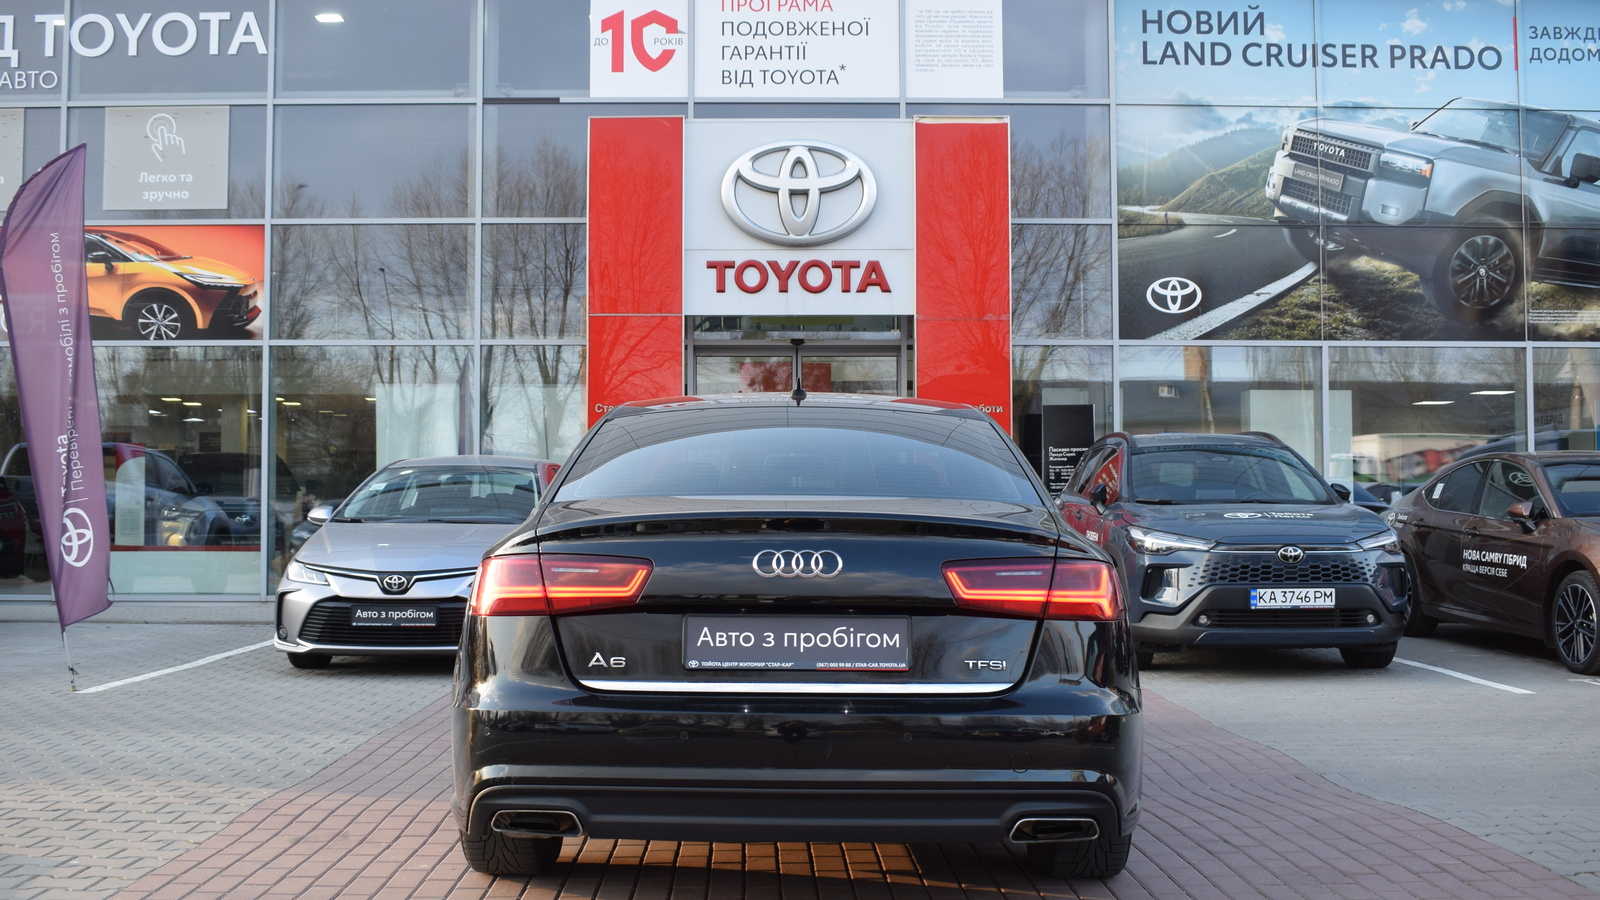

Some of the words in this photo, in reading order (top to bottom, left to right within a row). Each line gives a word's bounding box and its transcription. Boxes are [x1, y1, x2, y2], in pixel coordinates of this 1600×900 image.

[721, 17, 871, 38] ПОДОВЖЕНОЇ
[1141, 4, 1265, 36] НОВИЙ
[35, 11, 268, 58] TOYOTA
[593, 37, 609, 47] ДО
[653, 37, 684, 46] РОКІВ
[1528, 25, 1600, 43] ЗАВЖД
[721, 41, 807, 60] ГАРАНТІЇ
[1141, 40, 1233, 66] LAND
[1241, 42, 1379, 69] CRUISER
[1389, 44, 1503, 71] PRADO
[0, 70, 59, 90] АВТО
[721, 69, 755, 88] ВІД
[1313, 142, 1345, 157] TOYOTA
[138, 172, 177, 183] Легко
[178, 173, 193, 183] та
[142, 189, 190, 201] зручно
[50, 232, 68, 303] пробігом
[706, 259, 892, 294] TOYOTA
[1463, 549, 1480, 561] НОВА
[1480, 551, 1503, 563] CAMRY
[1502, 553, 1527, 569] ГІБРИД
[1462, 563, 1479, 574] КРАЩА
[1479, 565, 1495, 575] ВЕРСІЯ
[1495, 567, 1508, 577] СЕБЕ
[1258, 590, 1277, 603] KA
[1280, 590, 1312, 603] 3746
[1314, 590, 1333, 603] PM
[355, 609, 378, 618] Авто
[388, 609, 434, 620] пробігом
[697, 626, 756, 648] Авто
[762, 632, 776, 648] з
[783, 626, 900, 653] пробігом
[588, 653, 626, 669] A6
[965, 660, 1007, 672] TFSI
